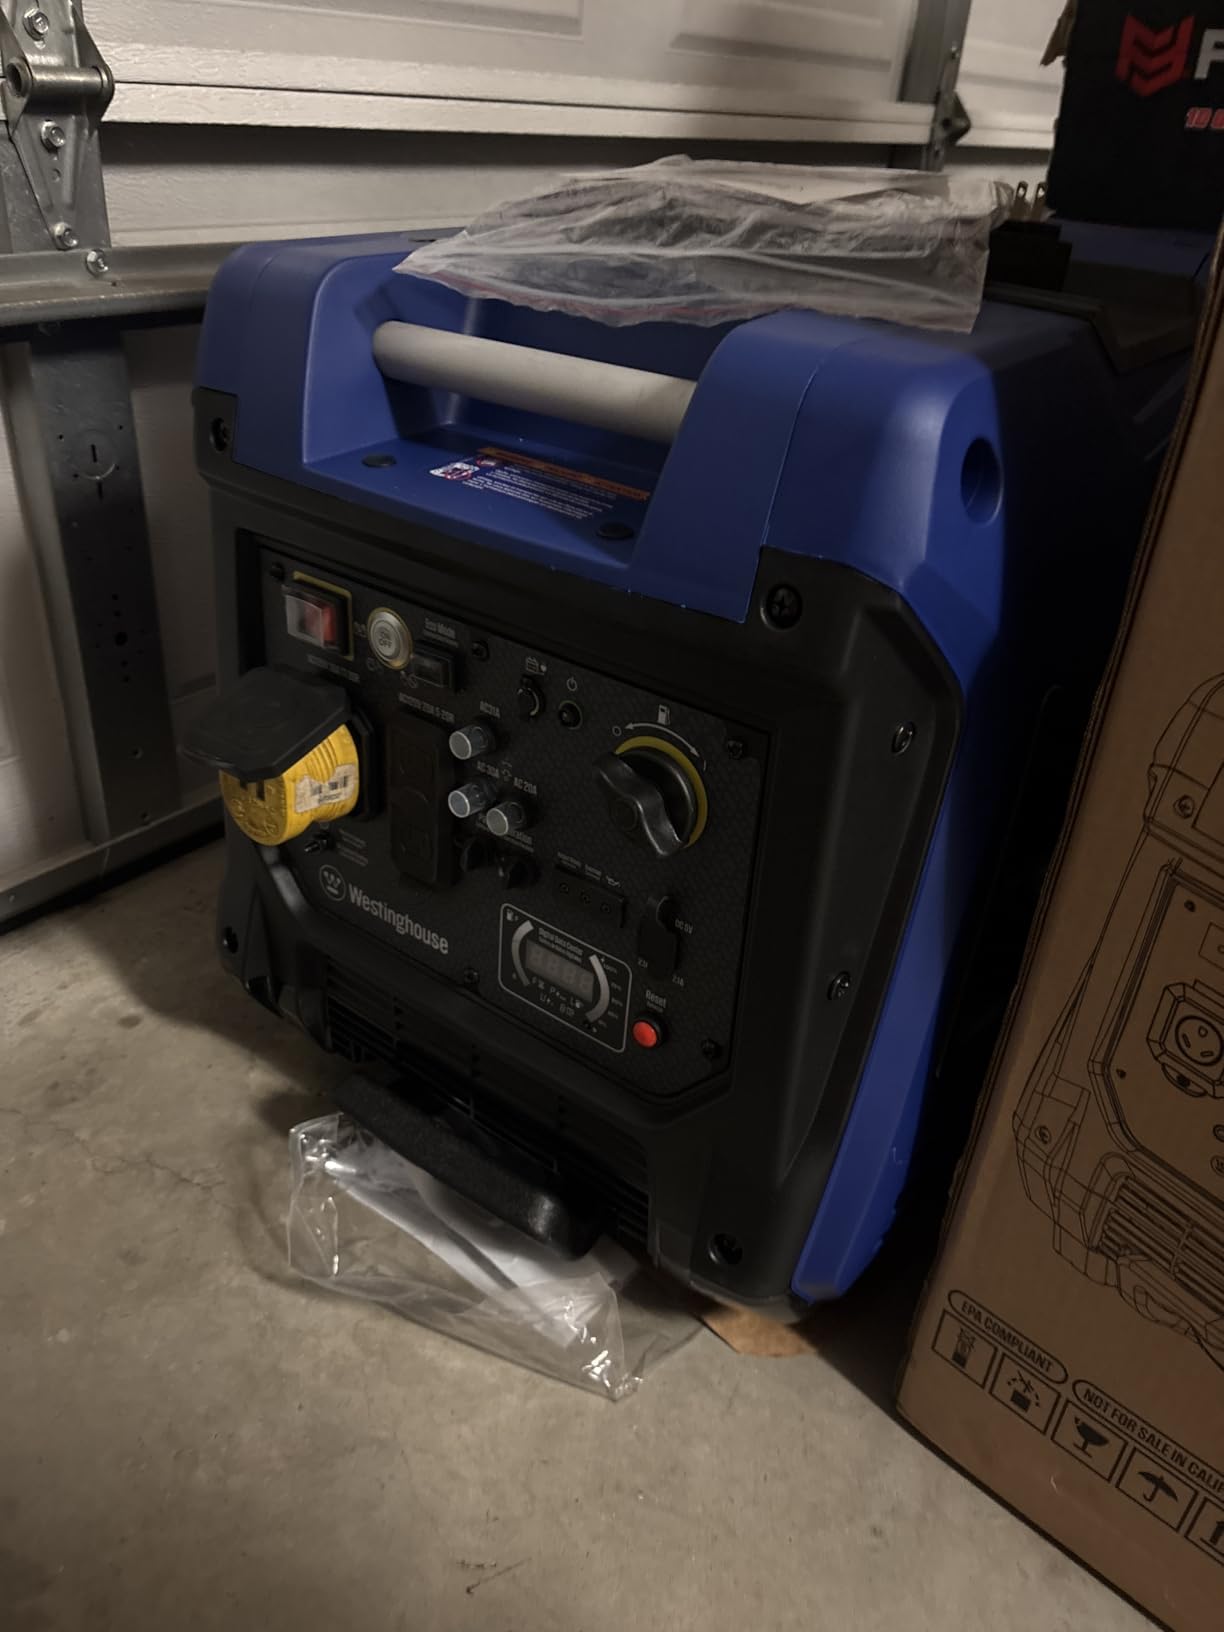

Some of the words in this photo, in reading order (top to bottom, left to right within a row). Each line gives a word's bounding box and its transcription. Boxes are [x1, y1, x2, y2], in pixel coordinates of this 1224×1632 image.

[348, 883, 449, 954] Westinghouse
[961, 1300, 982, 1323] EPA
[984, 1312, 1053, 1373] COMPLIANT
[1084, 1388, 1111, 1414] NOT
[1111, 1405, 1138, 1433] FOR
[1137, 1422, 1172, 1457] SALE
[1171, 1449, 1188, 1468] IN
